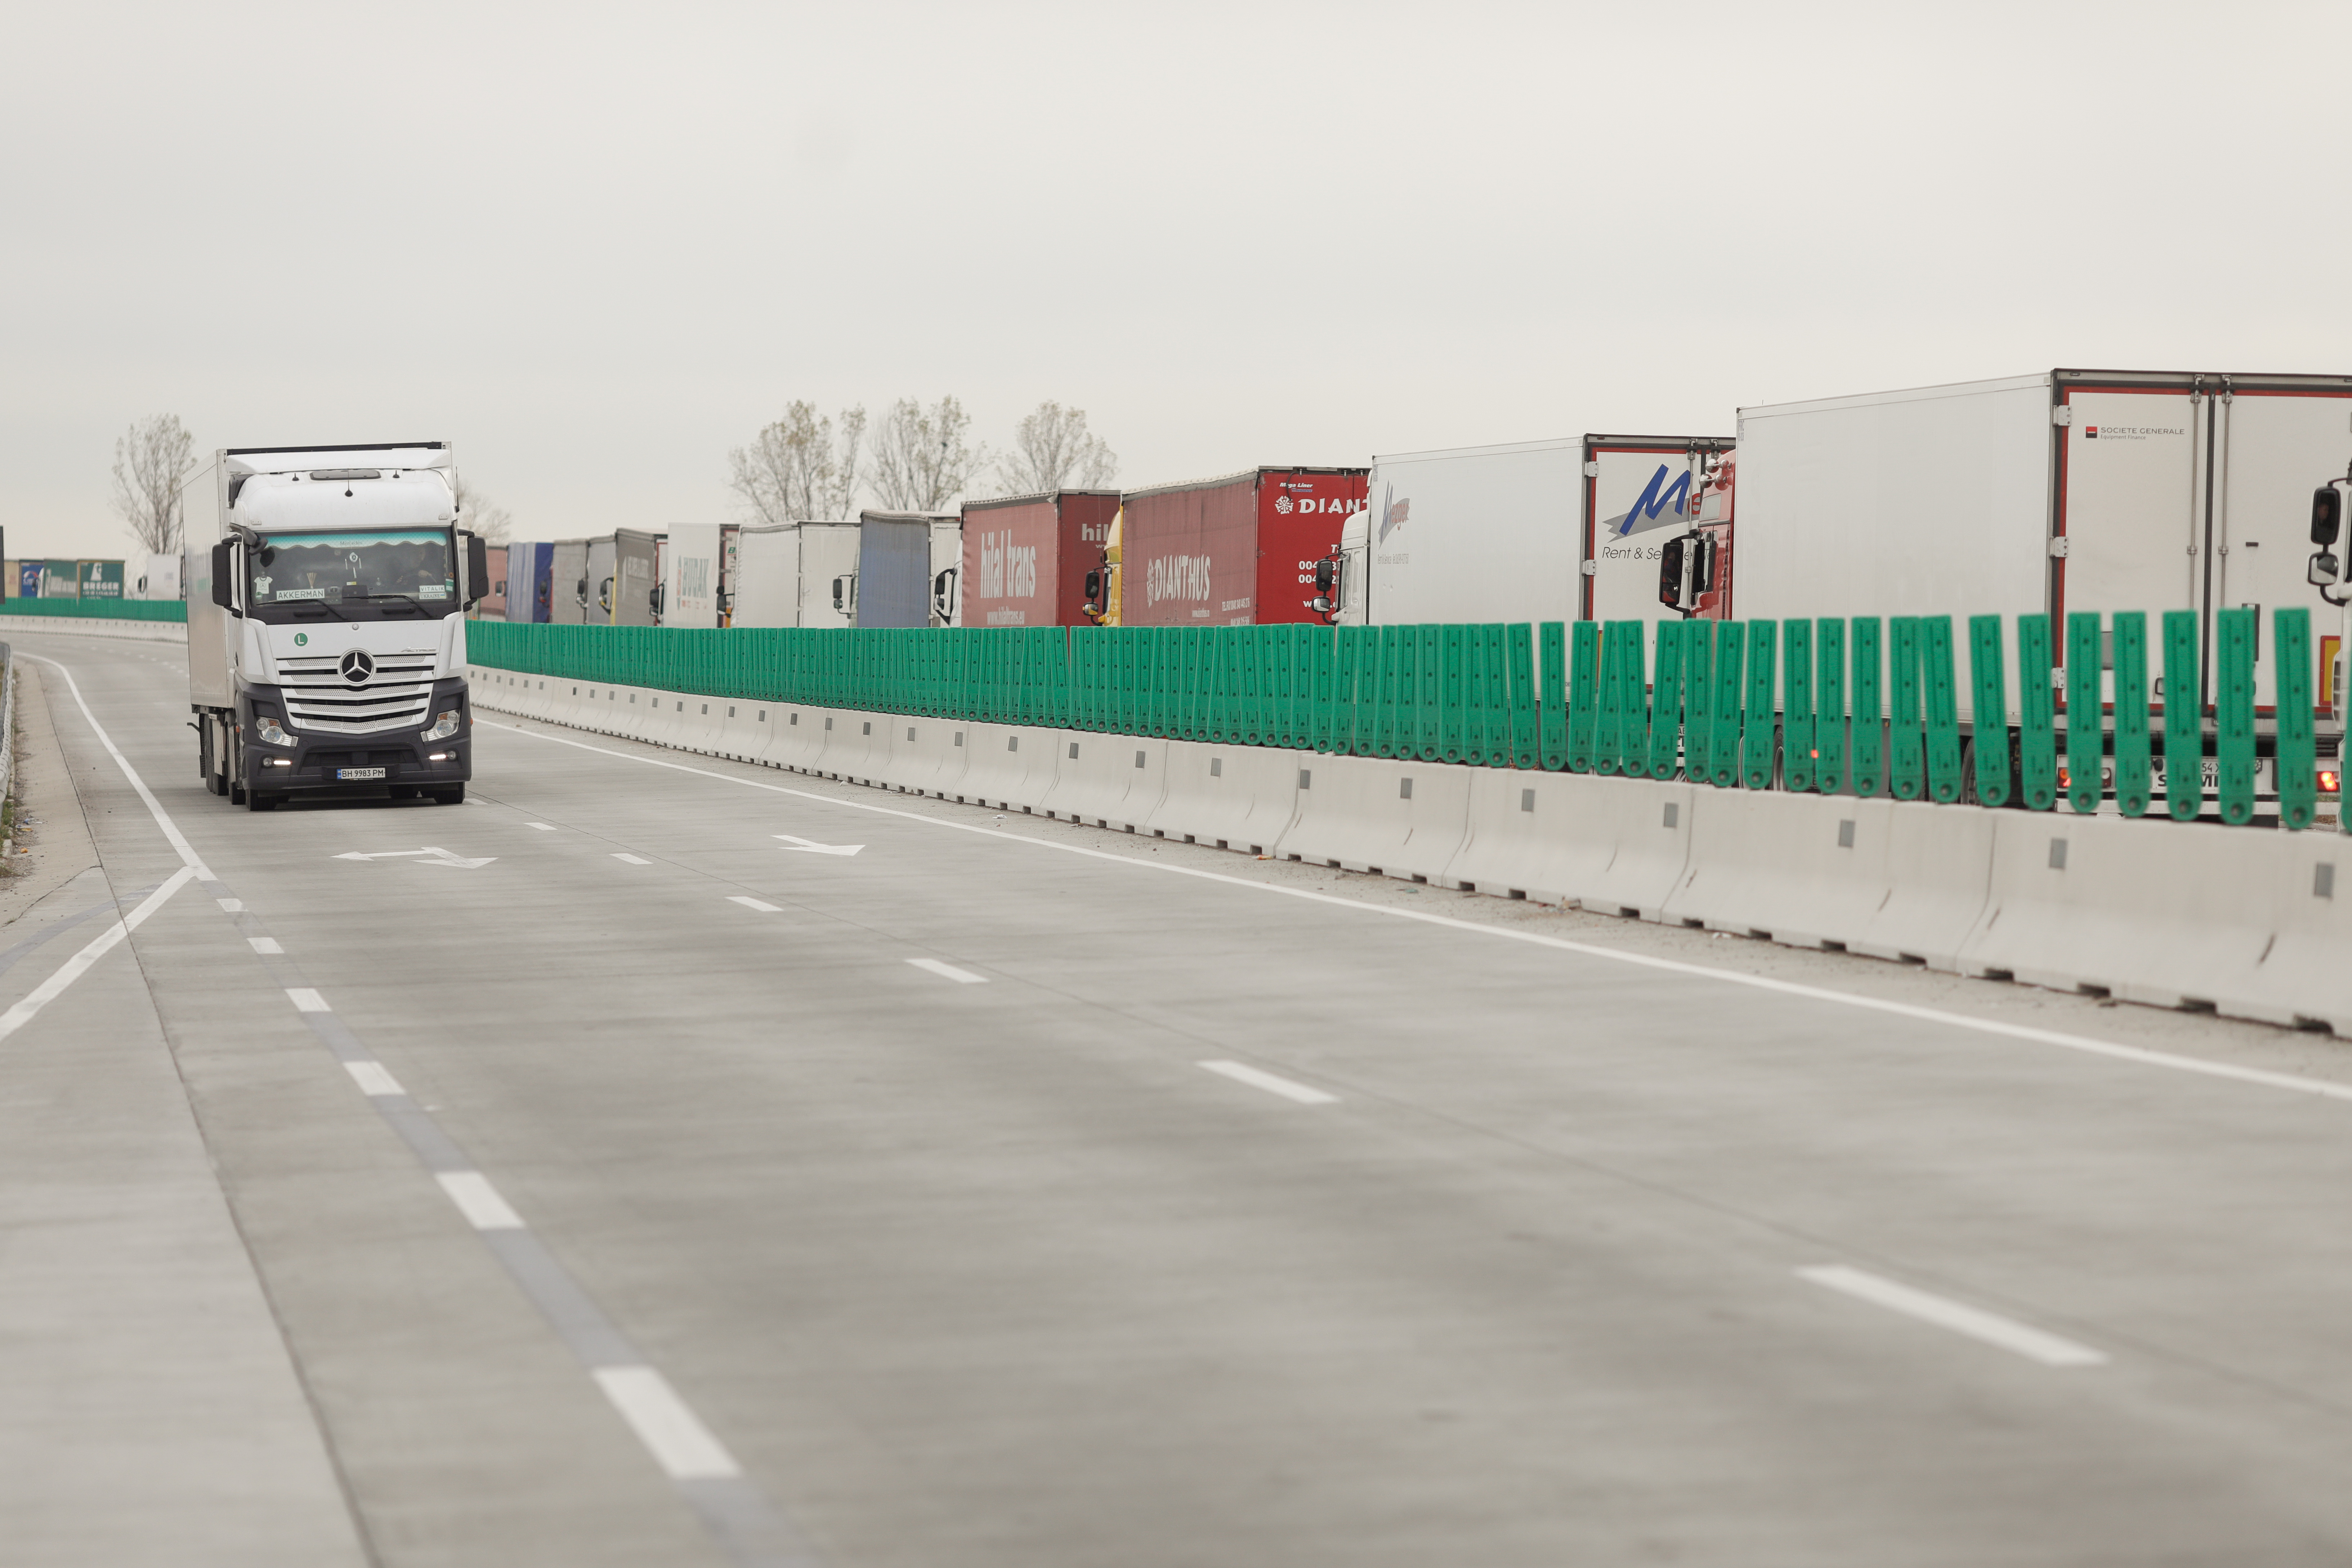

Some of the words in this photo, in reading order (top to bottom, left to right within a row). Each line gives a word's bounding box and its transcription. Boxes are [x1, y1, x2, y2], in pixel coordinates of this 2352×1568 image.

[1602, 546, 1631, 559] Rent
[1634, 547, 1643, 559] &
[980, 530, 1004, 598] hilal
[1007, 529, 1036, 598] trans
[1154, 554, 1211, 602] DIANTHUS
[278, 590, 323, 599] AKKERMAN
[298, 635, 304, 644] L
